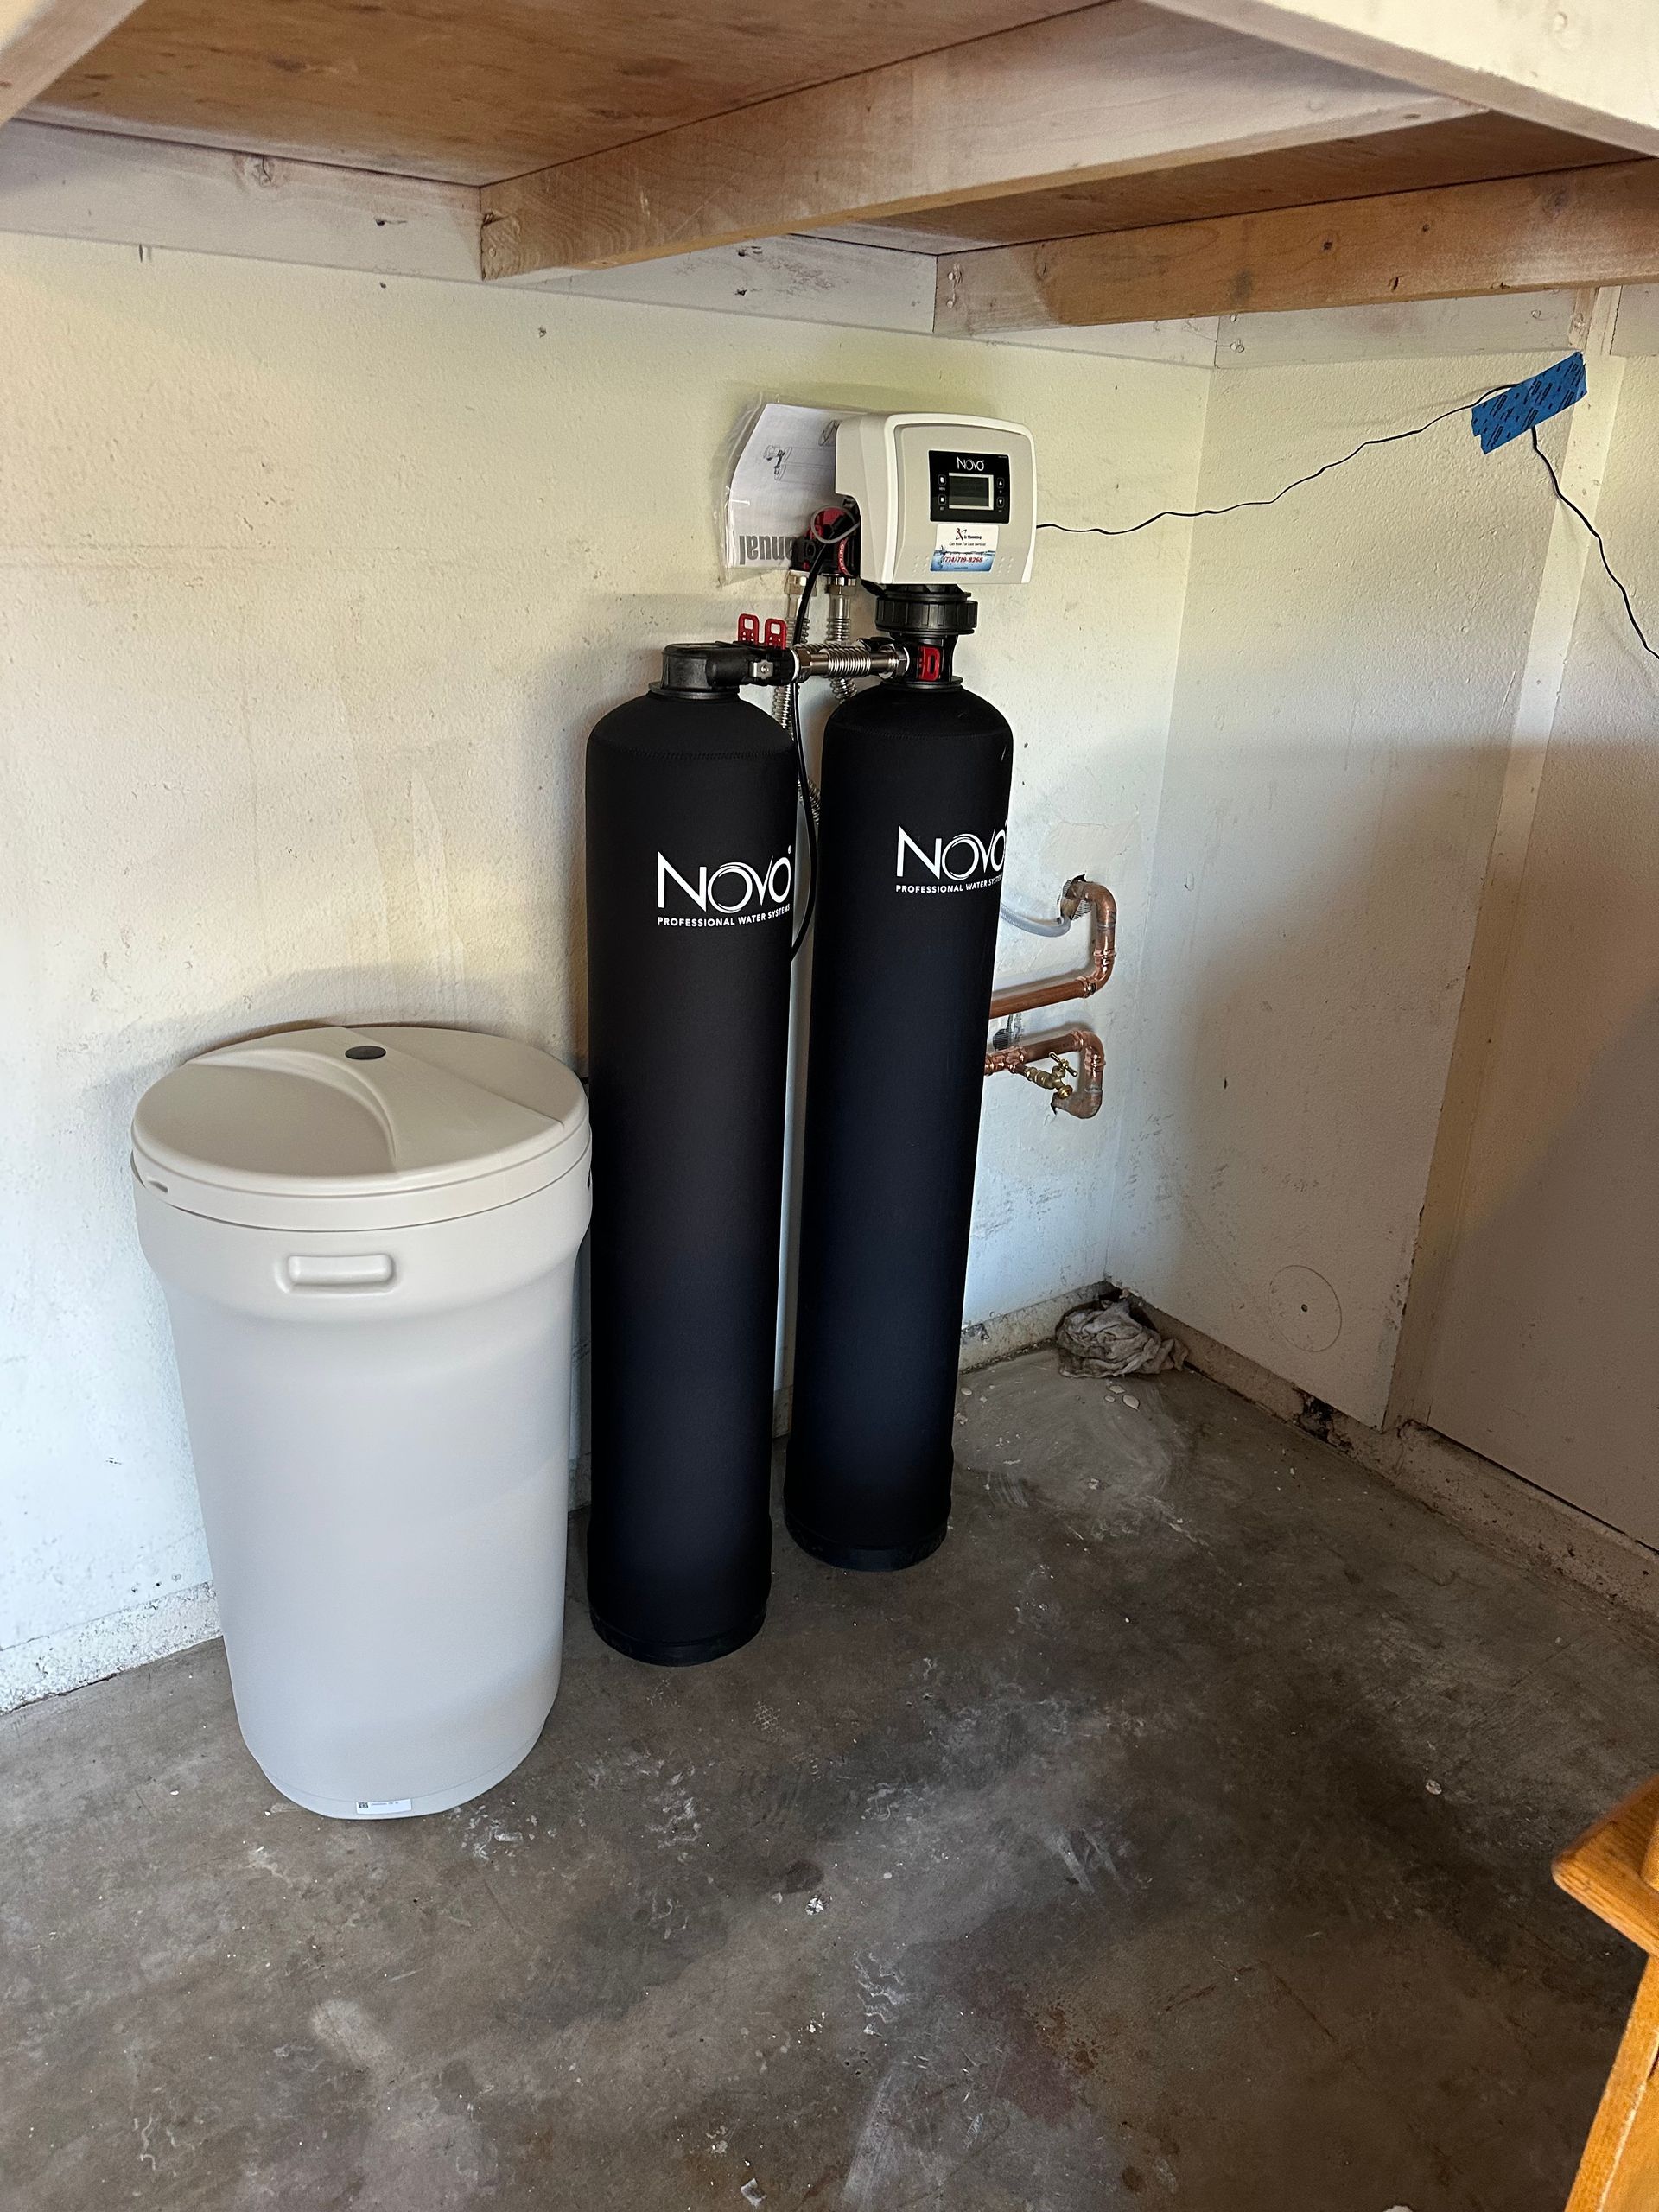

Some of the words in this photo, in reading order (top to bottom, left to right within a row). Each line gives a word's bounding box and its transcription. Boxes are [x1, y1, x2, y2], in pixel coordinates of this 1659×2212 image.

[895, 884, 963, 893] PROFESSIONAL
[965, 880, 988, 891] WATER
[657, 916, 735, 927] PROFESSIONAL
[737, 912, 766, 925] WATER
[767, 903, 791, 920] SYSTEMS
